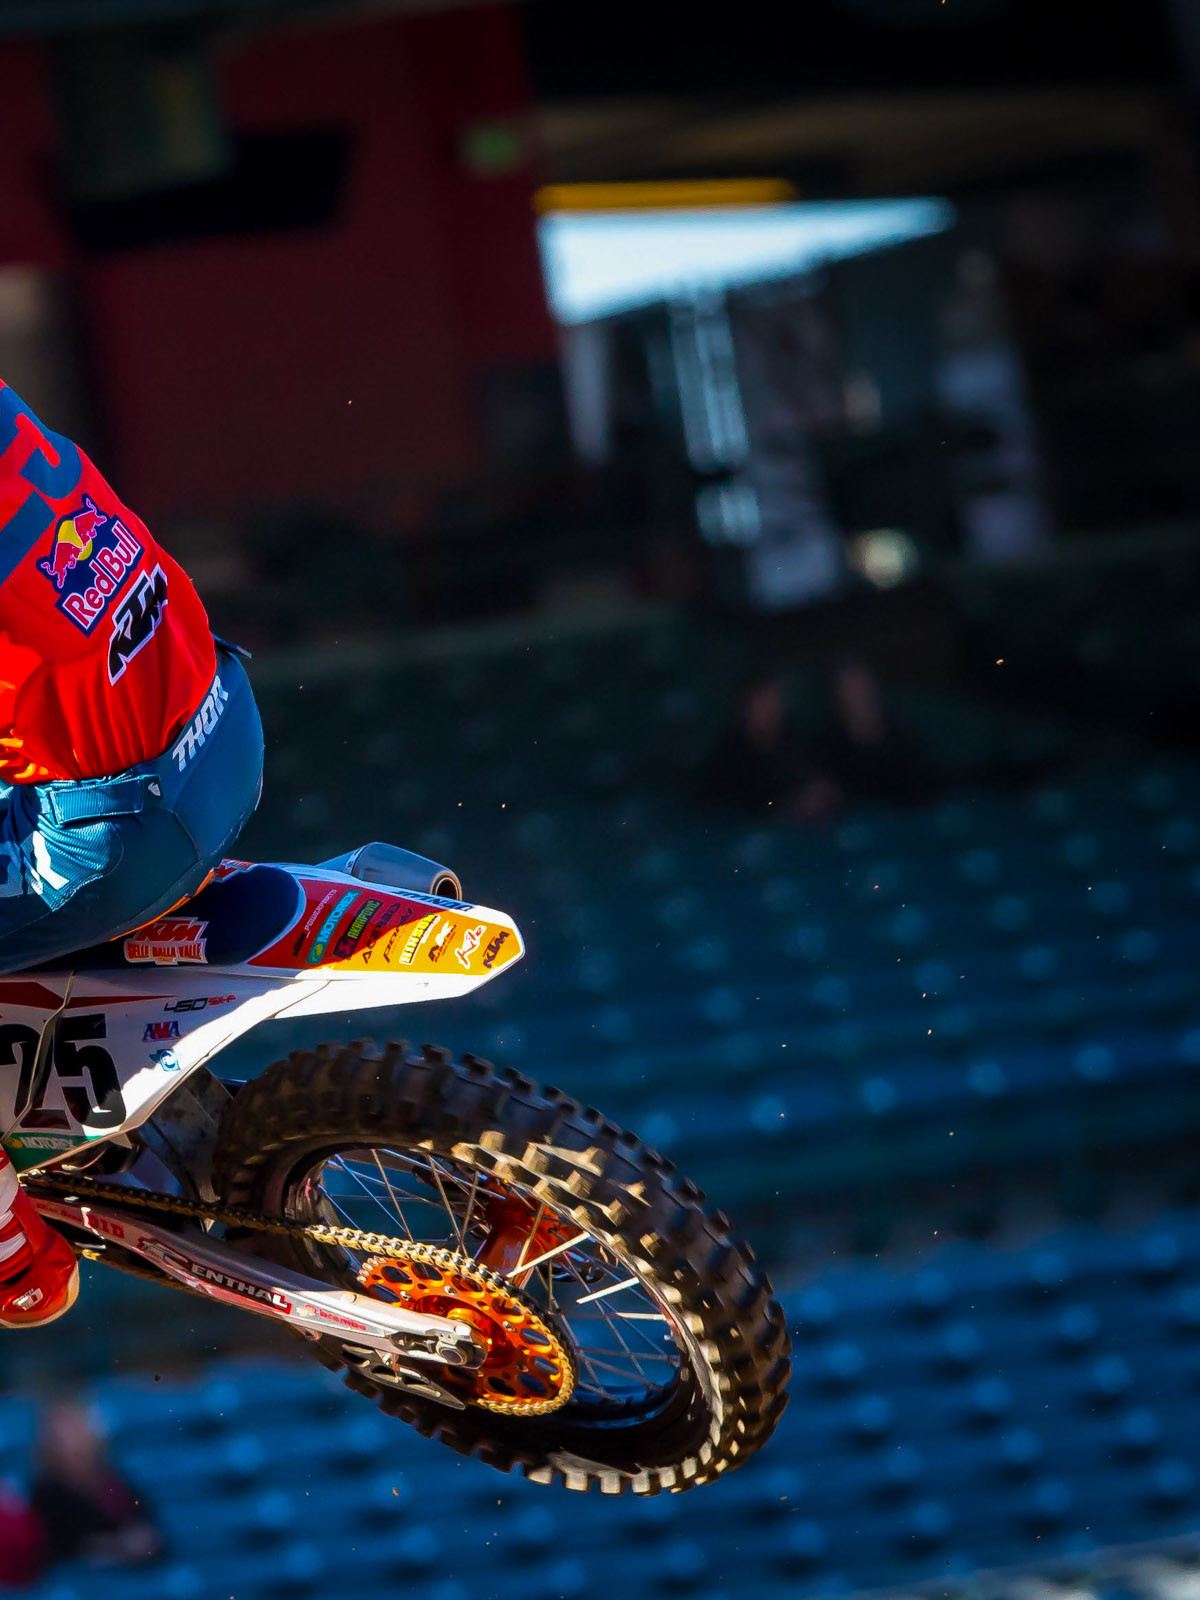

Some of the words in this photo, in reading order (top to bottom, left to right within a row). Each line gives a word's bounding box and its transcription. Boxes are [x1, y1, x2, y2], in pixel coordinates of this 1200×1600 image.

[108, 563, 168, 687] KTM
[172, 674, 229, 773] THOR
[316, 889, 360, 943] MOTOREX
[482, 930, 510, 969] KTM
[142, 1020, 181, 1042] AMA
[318, 1308, 367, 1331] brembo
